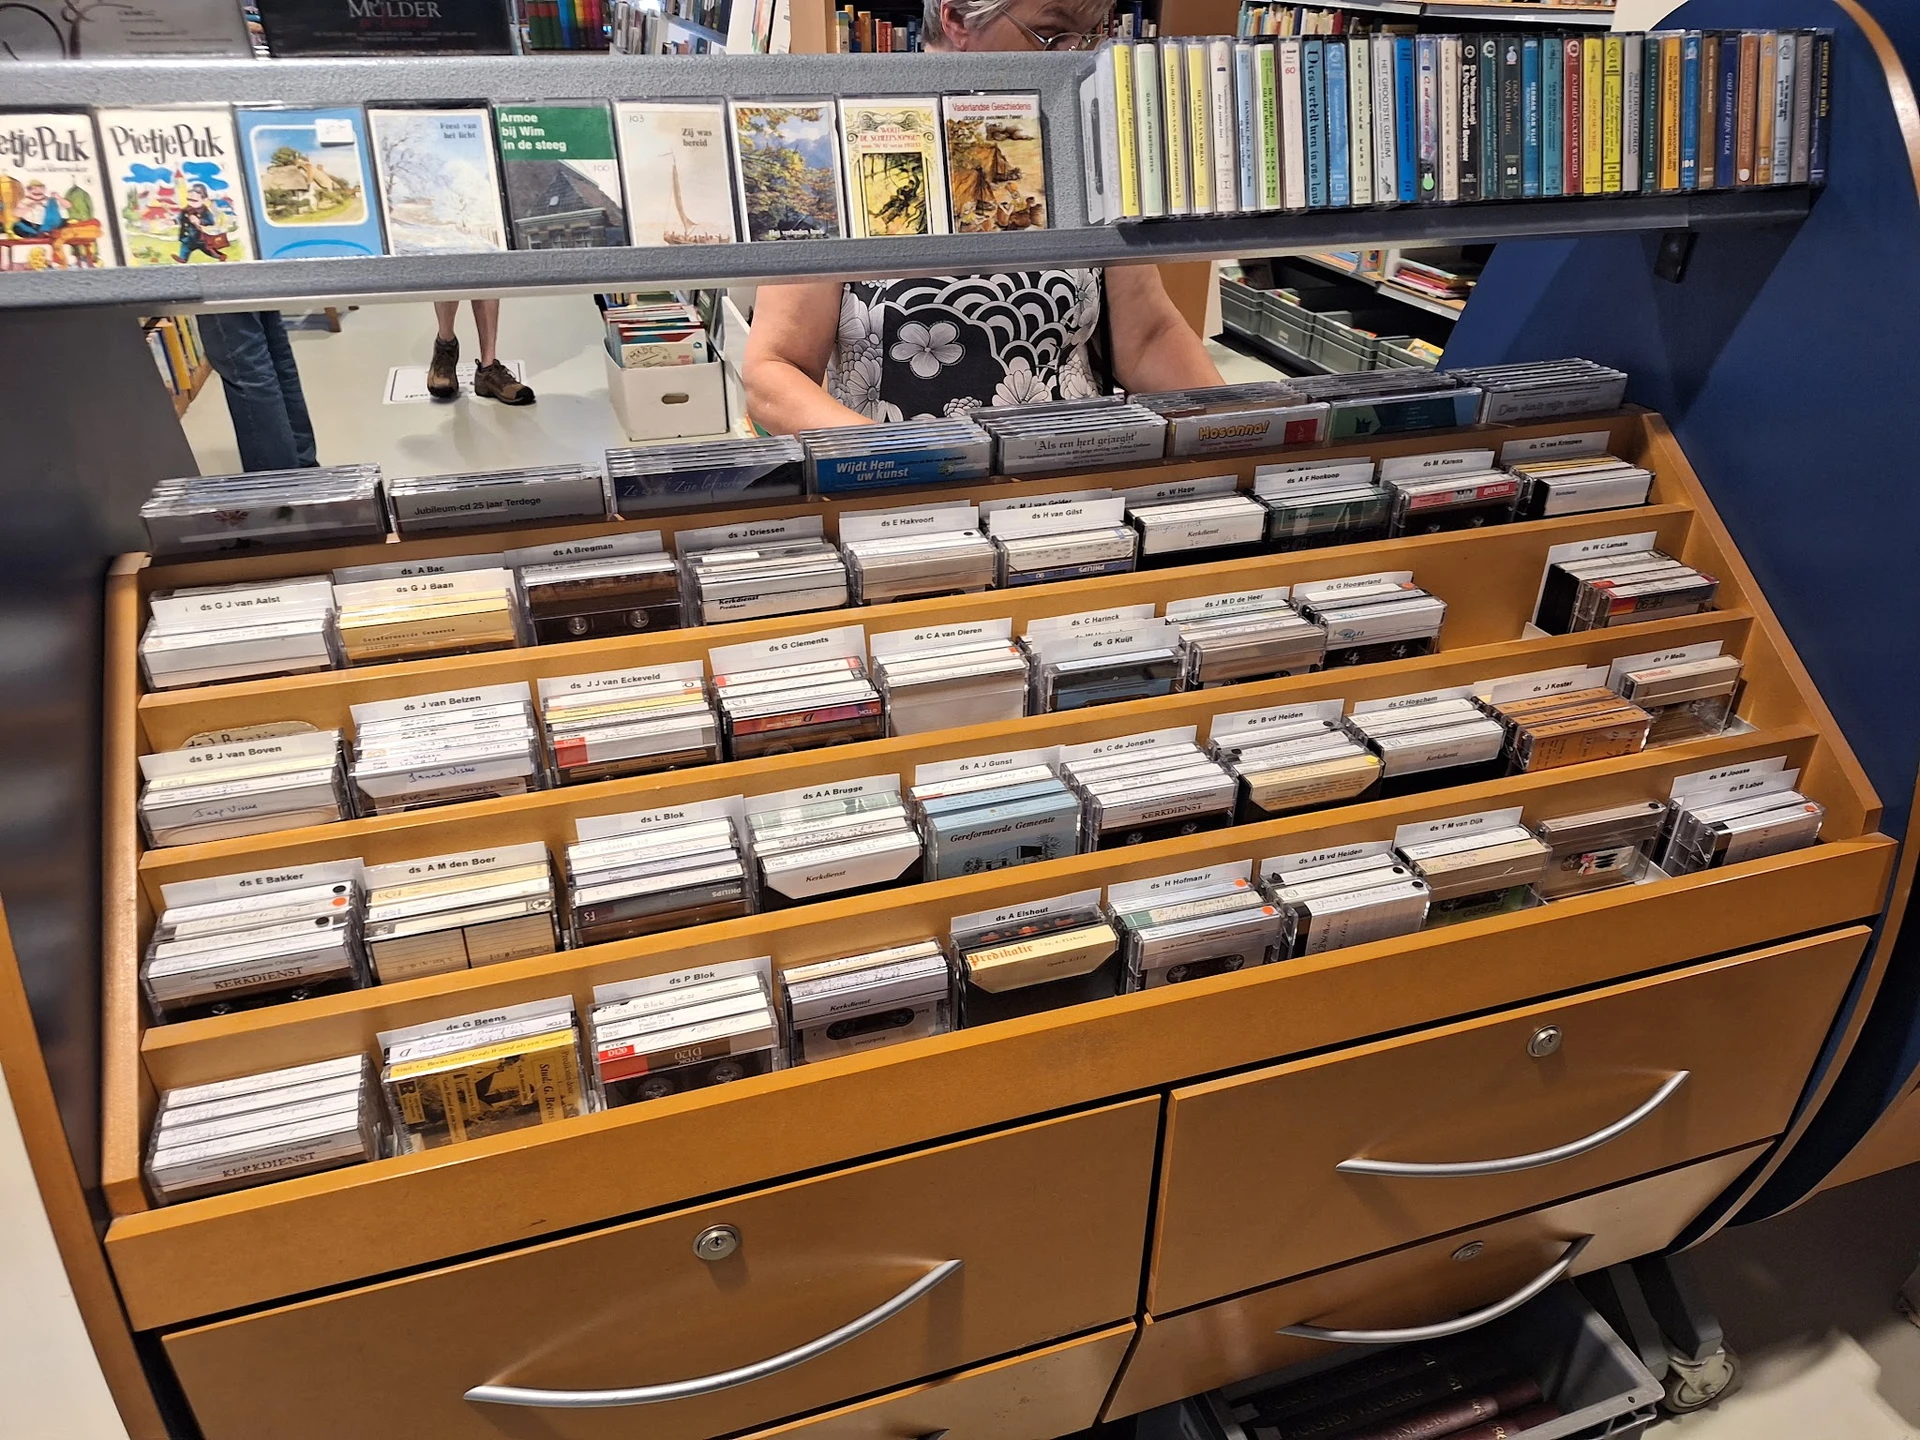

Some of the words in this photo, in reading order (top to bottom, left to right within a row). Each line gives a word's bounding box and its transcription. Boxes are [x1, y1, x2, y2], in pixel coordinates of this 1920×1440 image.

[952, 103, 990, 112] Vaderlandse
[991, 102, 1031, 111] Geschiedenis
[1309, 87, 1319, 122] vertelt
[501, 113, 537, 123] Armoe
[458, 131, 475, 139] licht
[502, 126, 516, 138] bij
[520, 127, 544, 136] Wim
[681, 128, 694, 137] Zij
[503, 141, 515, 150] in
[519, 140, 532, 150] de
[536, 140, 567, 152] steeg
[683, 139, 708, 147] bereid
[1310, 151, 1319, 160] in
[1310, 163, 1318, 179] ons
[1311, 183, 1321, 204] land
[1200, 421, 1269, 440] Hosanna!
[1076, 437, 1095, 449] hert
[836, 462, 868, 473] Wijdt
[871, 460, 894, 470] Hem
[857, 471, 874, 481] uw
[876, 468, 908, 479] kunst
[1179, 486, 1195, 495] Hage
[414, 504, 470, 516] Jubileum-cd
[472, 502, 484, 511] 25
[485, 499, 503, 512] jaar
[505, 497, 541, 507] Terdege
[1066, 508, 1082, 516] Gilst
[900, 516, 934, 525] Hakvoort
[749, 527, 785, 536] Driessen
[1188, 528, 1219, 538] Kerkdienst
[553, 549, 564, 557] ds
[575, 543, 613, 555] Bregman
[401, 568, 413, 577] ds
[418, 566, 425, 574] A
[426, 565, 444, 575] Bac
[396, 585, 407, 593] ds
[410, 584, 418, 592] G
[430, 582, 454, 590] Baan
[1343, 578, 1382, 588] Hoogerland
[214, 602, 222, 610] G
[226, 601, 232, 609] J
[256, 596, 280, 605] Aalst
[719, 594, 759, 605] Kerkdienst
[1092, 613, 1120, 623] Harinck
[957, 628, 982, 636] Dieren
[791, 637, 829, 648] Clements
[421, 701, 426, 709] J
[428, 700, 447, 708] van
[449, 695, 481, 705] Belzen
[1278, 712, 1303, 721] Heiden
[1125, 738, 1155, 751] Jongste
[205, 753, 213, 761] B
[224, 749, 245, 758] van
[248, 746, 282, 755] Boven
[833, 786, 863, 797] Brugge
[640, 816, 652, 824] ds
[664, 811, 684, 820] Blok
[1142, 803, 1202, 820] KERKDIENST
[950, 824, 1012, 843] Gereformeerde
[1015, 816, 1055, 830] Gemeente
[239, 879, 253, 887] ds
[256, 877, 263, 885] E
[266, 873, 303, 884] Bakker
[806, 870, 846, 882] Kerkdienst
[1173, 876, 1202, 886] Hofman
[1204, 873, 1211, 881] jr
[712, 888, 741, 898] PHILIPS
[1017, 906, 1048, 917] Elshout
[968, 944, 1033, 966] Predikatie
[214, 969, 302, 990] KERKDIENST
[694, 971, 715, 981] Blok
[830, 999, 871, 1012] Kerkdienst
[474, 1015, 507, 1027] Beens
[607, 1046, 629, 1058] D120
[674, 1048, 701, 1059] D120
[223, 1152, 315, 1178] KERKDIENST
